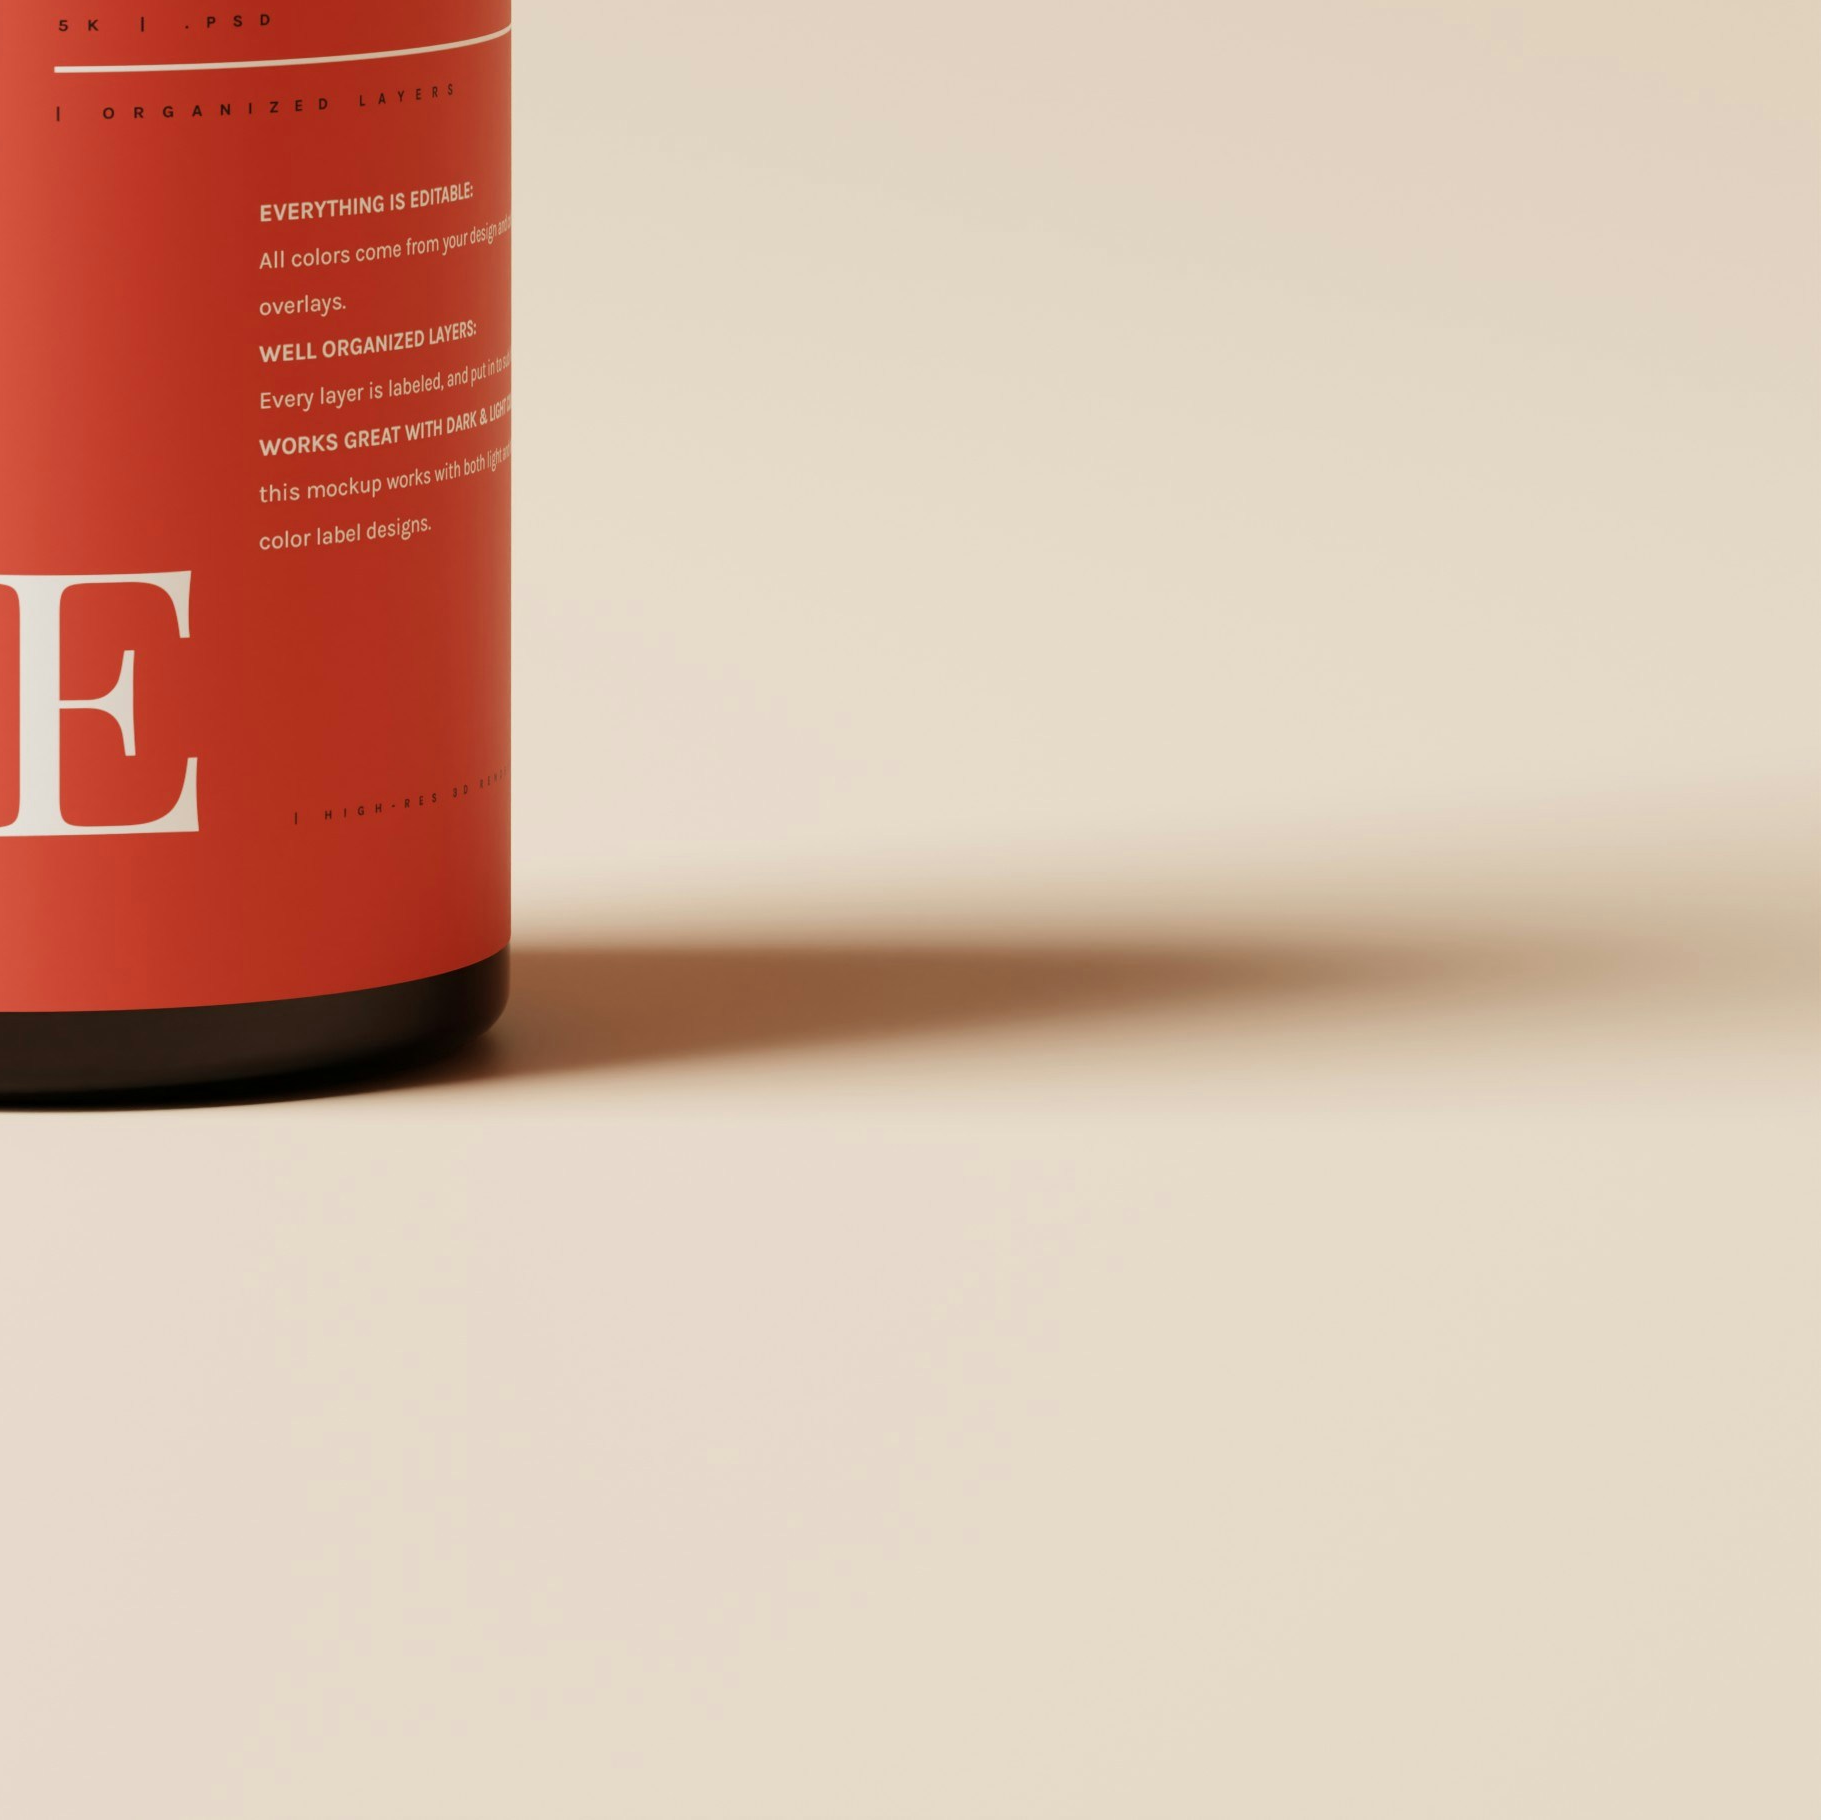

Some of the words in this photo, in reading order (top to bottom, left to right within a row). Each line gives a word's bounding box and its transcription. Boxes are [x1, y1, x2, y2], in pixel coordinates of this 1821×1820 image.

[58, 18, 100, 33] 5K
[102, 97, 328, 120] ORGANIZED
[359, 83, 454, 107] LAYERS
[259, 194, 385, 222] EVERYTHING
[390, 192, 406, 211] IS
[410, 181, 474, 209] EDITABLE:
[259, 250, 285, 270] All
[291, 247, 351, 268] colors
[355, 242, 402, 262] come
[405, 236, 440, 256] from
[442, 231, 469, 256] your
[469, 221, 498, 245] design
[259, 295, 347, 317] overlays.
[259, 342, 317, 364] WELL
[322, 329, 425, 359] ORGANIZED
[428, 319, 477, 345] LAYERS:
[259, 392, 314, 412] Every
[320, 385, 365, 409] layer
[369, 381, 384, 400] is
[388, 372, 445, 397] labeled,
[447, 365, 469, 388] and
[471, 361, 487, 387] put
[487, 358, 495, 377] in
[259, 433, 339, 457] WORKS
[343, 425, 401, 450] GREAT
[405, 418, 443, 442] WITH
[446, 410, 478, 435] DARK
[479, 407, 488, 426] &
[489, 398, 507, 423] LIGHT
[259, 483, 301, 504] this
[307, 477, 382, 499] mockup
[386, 468, 432, 491] works
[434, 462, 462, 483] with
[463, 455, 485, 477] both
[487, 448, 502, 473] light
[259, 530, 311, 551] color
[317, 524, 361, 546] label
[366, 516, 432, 541] designs.
[324, 793, 437, 820] HIGH-RES
